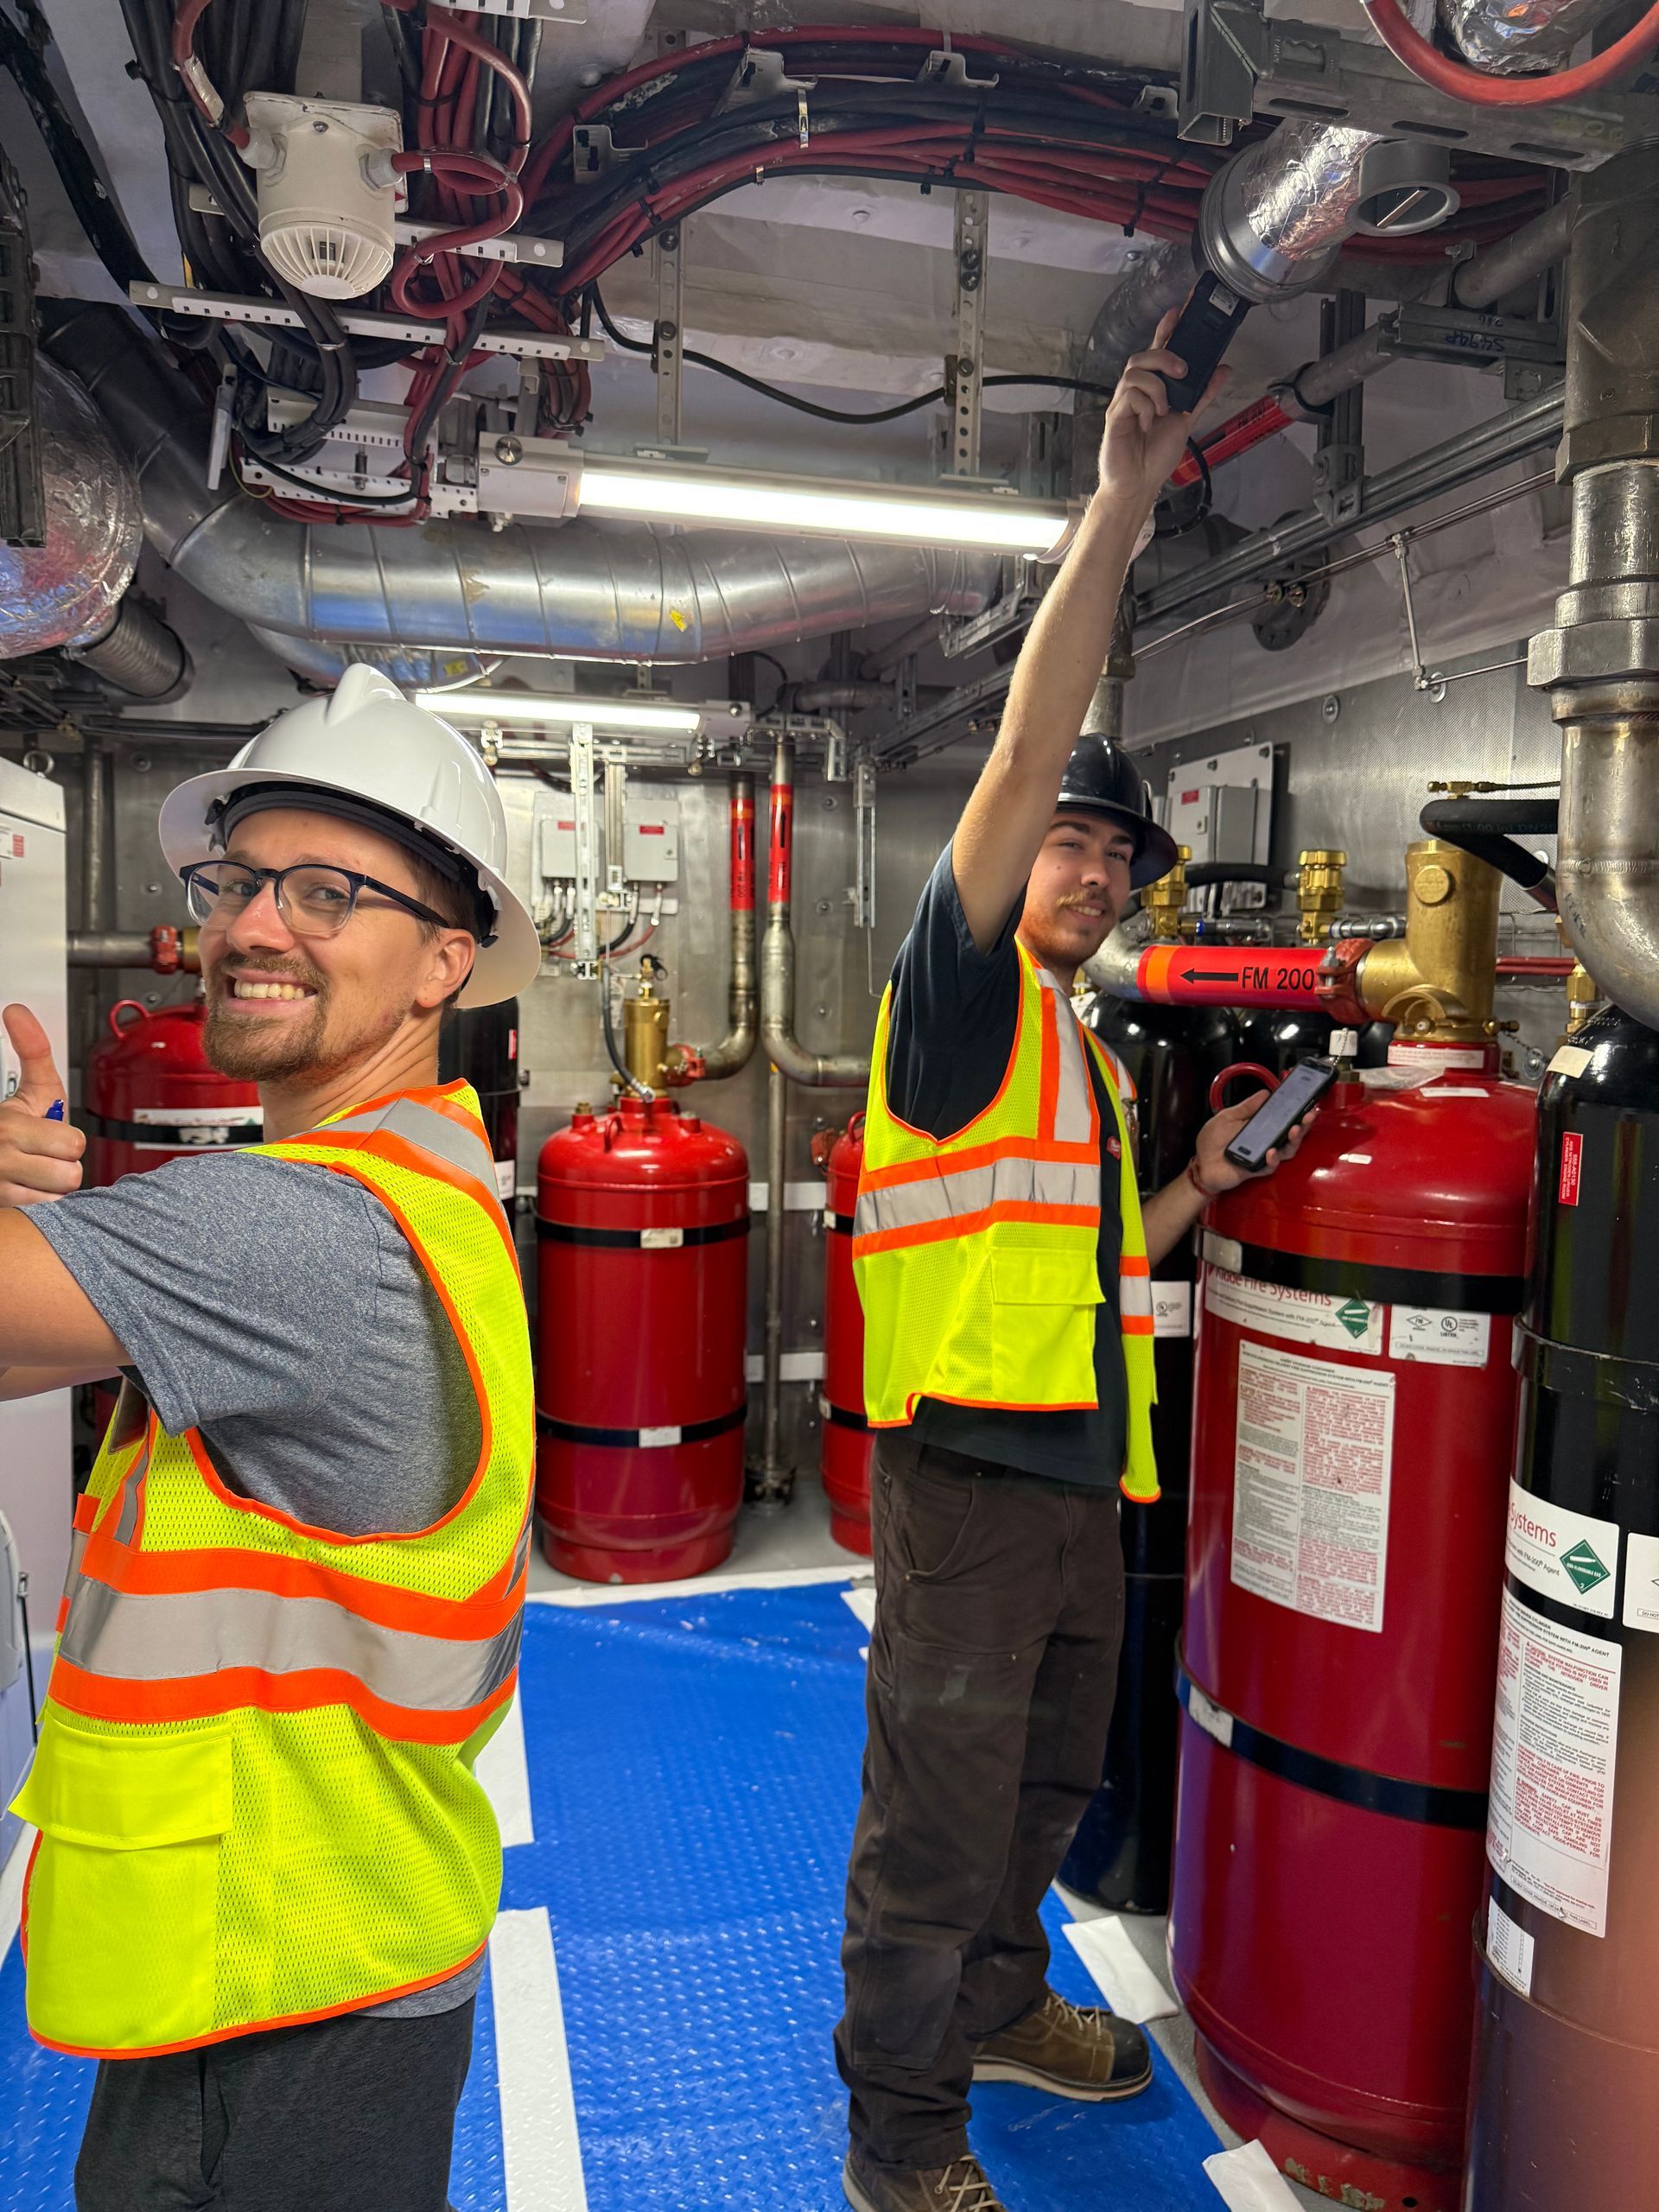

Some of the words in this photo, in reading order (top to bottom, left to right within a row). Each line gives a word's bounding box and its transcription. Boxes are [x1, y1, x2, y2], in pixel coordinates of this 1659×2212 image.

[1242, 966, 1268, 989] FM
[1276, 968, 1314, 991] 200
[1269, 1283, 1332, 1307] Systems
[1510, 1502, 1556, 1548] Systems
[1543, 1562, 1560, 1576] Agent
